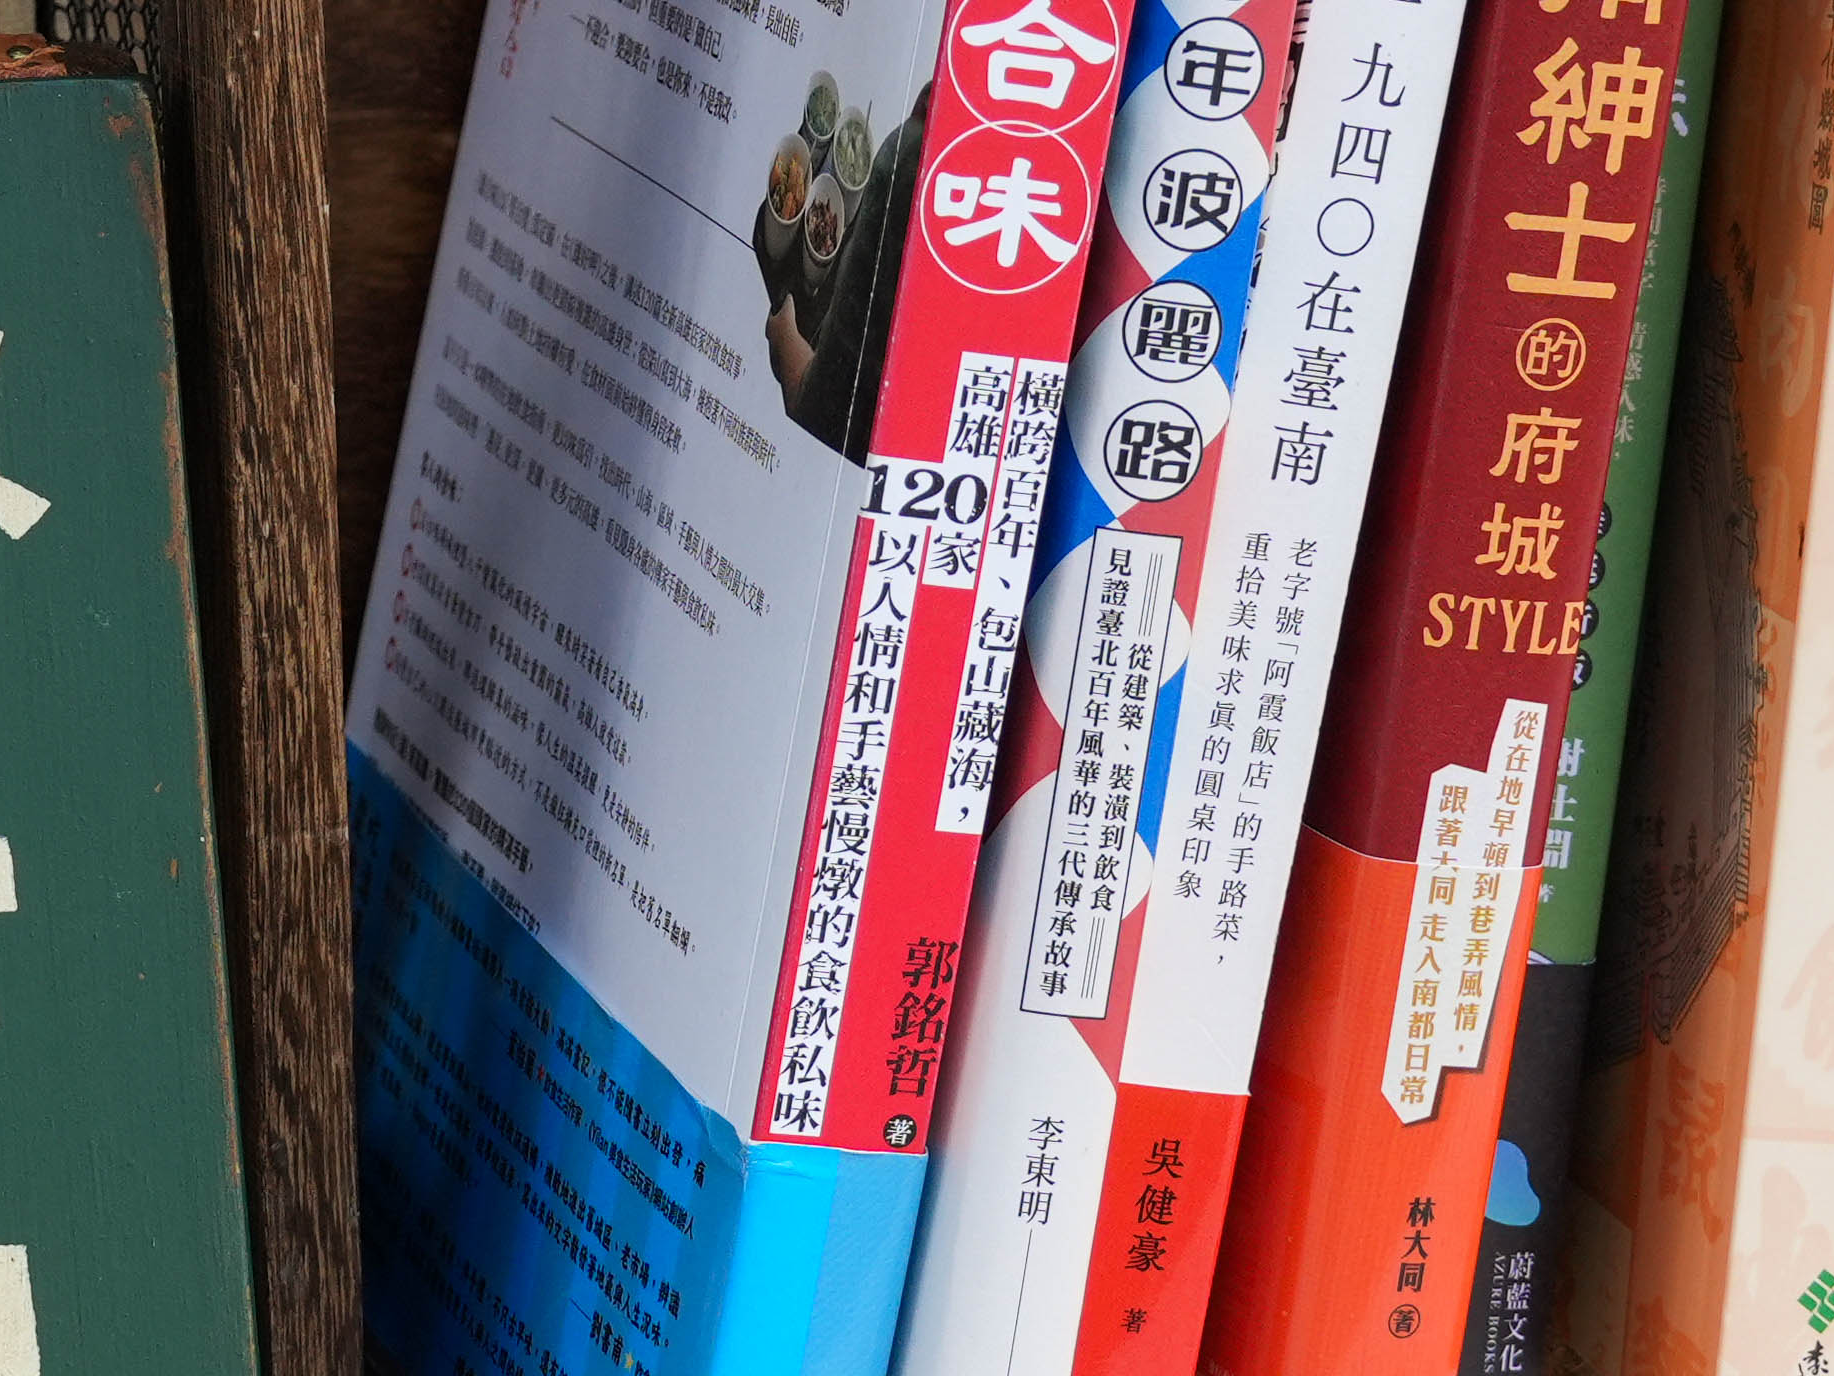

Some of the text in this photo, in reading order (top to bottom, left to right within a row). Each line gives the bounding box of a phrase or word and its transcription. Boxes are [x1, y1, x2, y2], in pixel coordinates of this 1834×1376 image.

[1422, 591, 1586, 656] STYLE
[773, 530, 920, 1133] 以人情和手藝慢燉的食飲私味
[1038, 547, 1134, 998] 見證臺北百年風華的三代傳承故事
[1089, 641, 1154, 912] 從建築、裝潢到飲食
[1212, 537, 1319, 966] 老字號「阿霞飯店」的手路菜，
[1398, 783, 1470, 1106] 跟著大同走入南都日常
[1452, 709, 1541, 1055] 從在地早頓到巷弄風情，
[885, 936, 959, 1149] 郭銘哲 著
[1017, 1116, 1065, 1226] 李東明
[1121, 1136, 1184, 1334] 吳健豪 著
[1389, 1196, 1437, 1339] 林大同 著
[1484, 1316, 1501, 1375] BOOKS
[1499, 1251, 1536, 1374] 蔚藍文化
